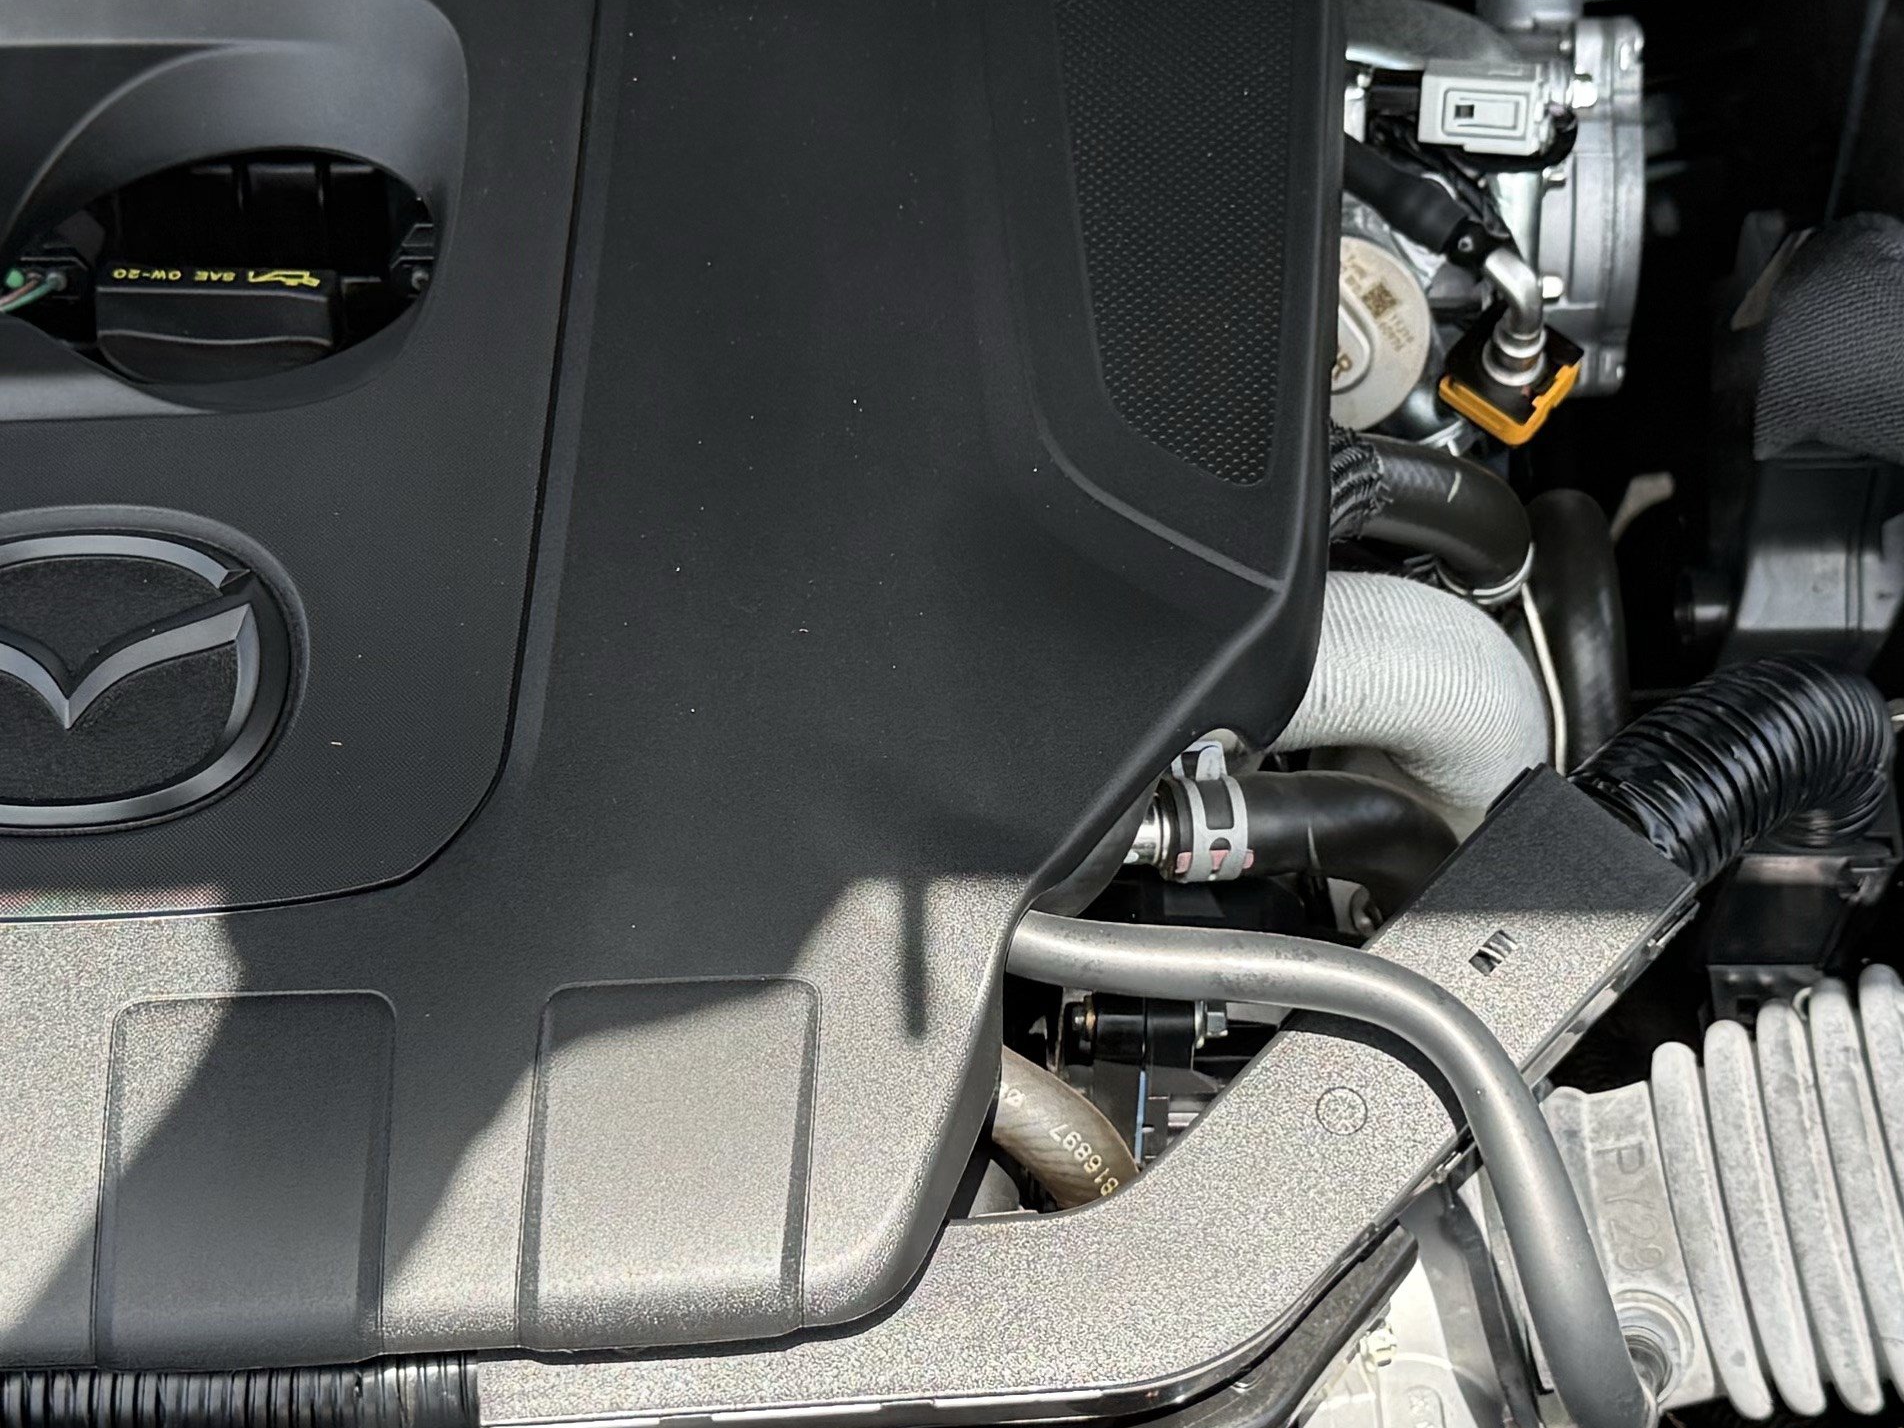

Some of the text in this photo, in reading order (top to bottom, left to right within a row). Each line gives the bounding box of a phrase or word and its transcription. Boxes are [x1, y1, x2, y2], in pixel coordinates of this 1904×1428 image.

[113, 269, 236, 282] SAE 0W-20
[1049, 1124, 1119, 1197] 816897
